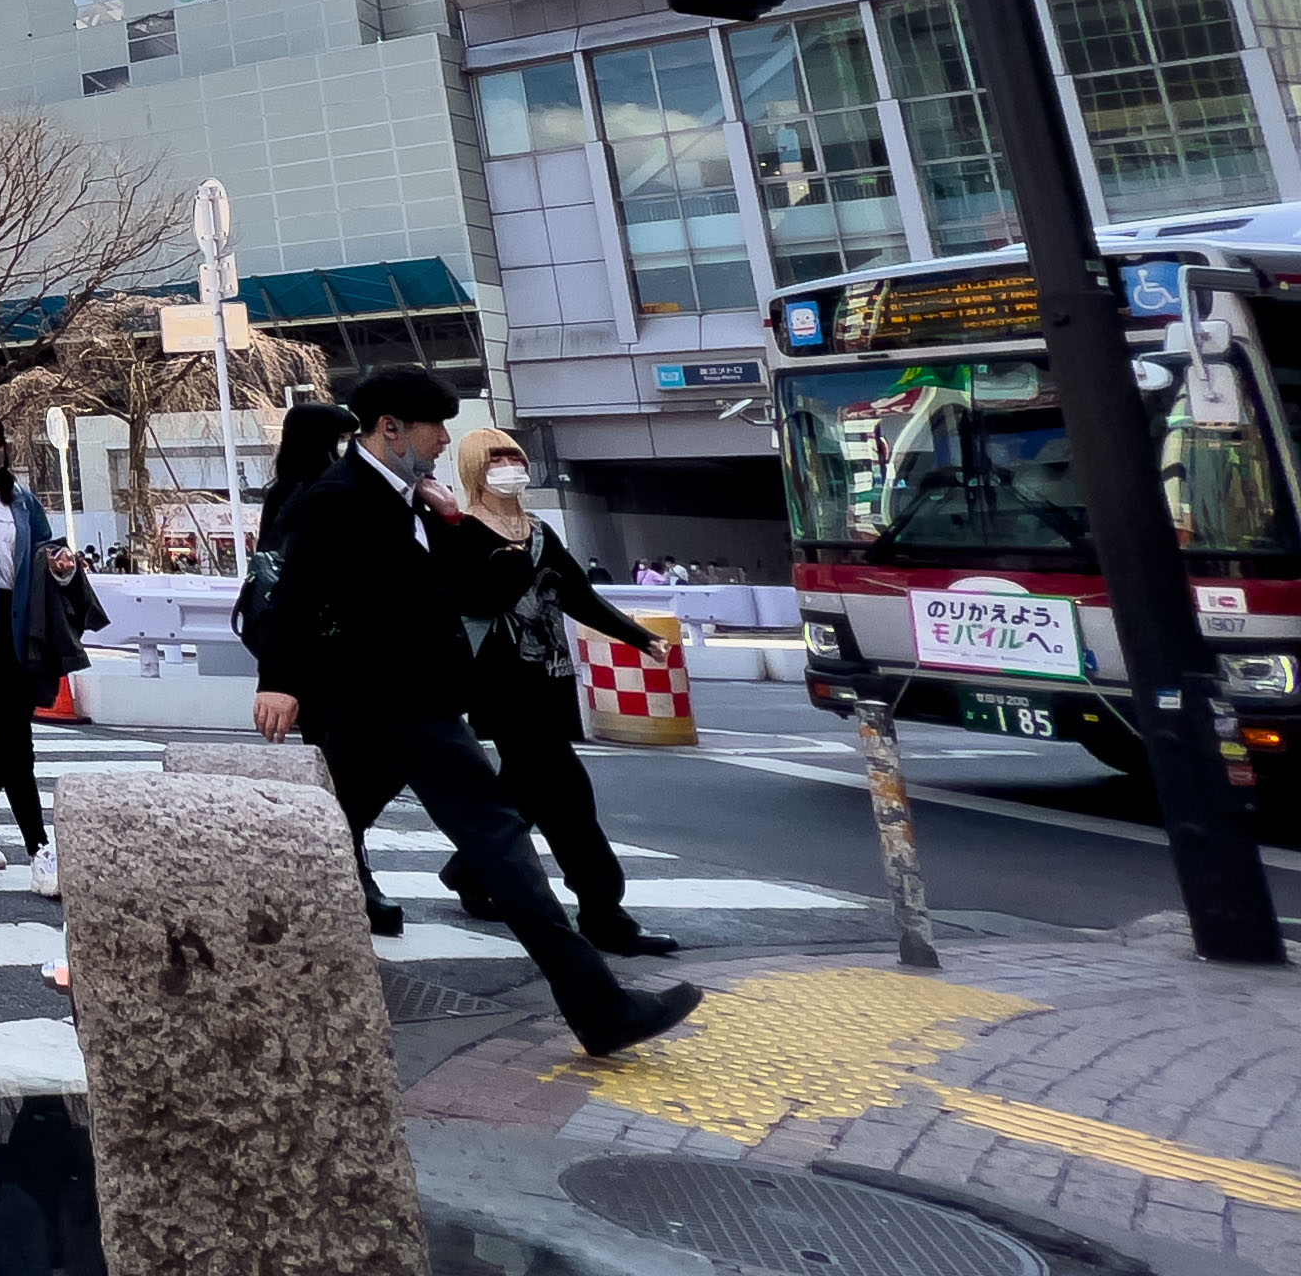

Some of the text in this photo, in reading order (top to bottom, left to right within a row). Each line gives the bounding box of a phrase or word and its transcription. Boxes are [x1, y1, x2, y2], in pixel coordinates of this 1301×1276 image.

[927, 600, 1060, 629] のりかえよう、
[931, 622, 1064, 654] モバイルへ。
[1005, 694, 1031, 707] 200
